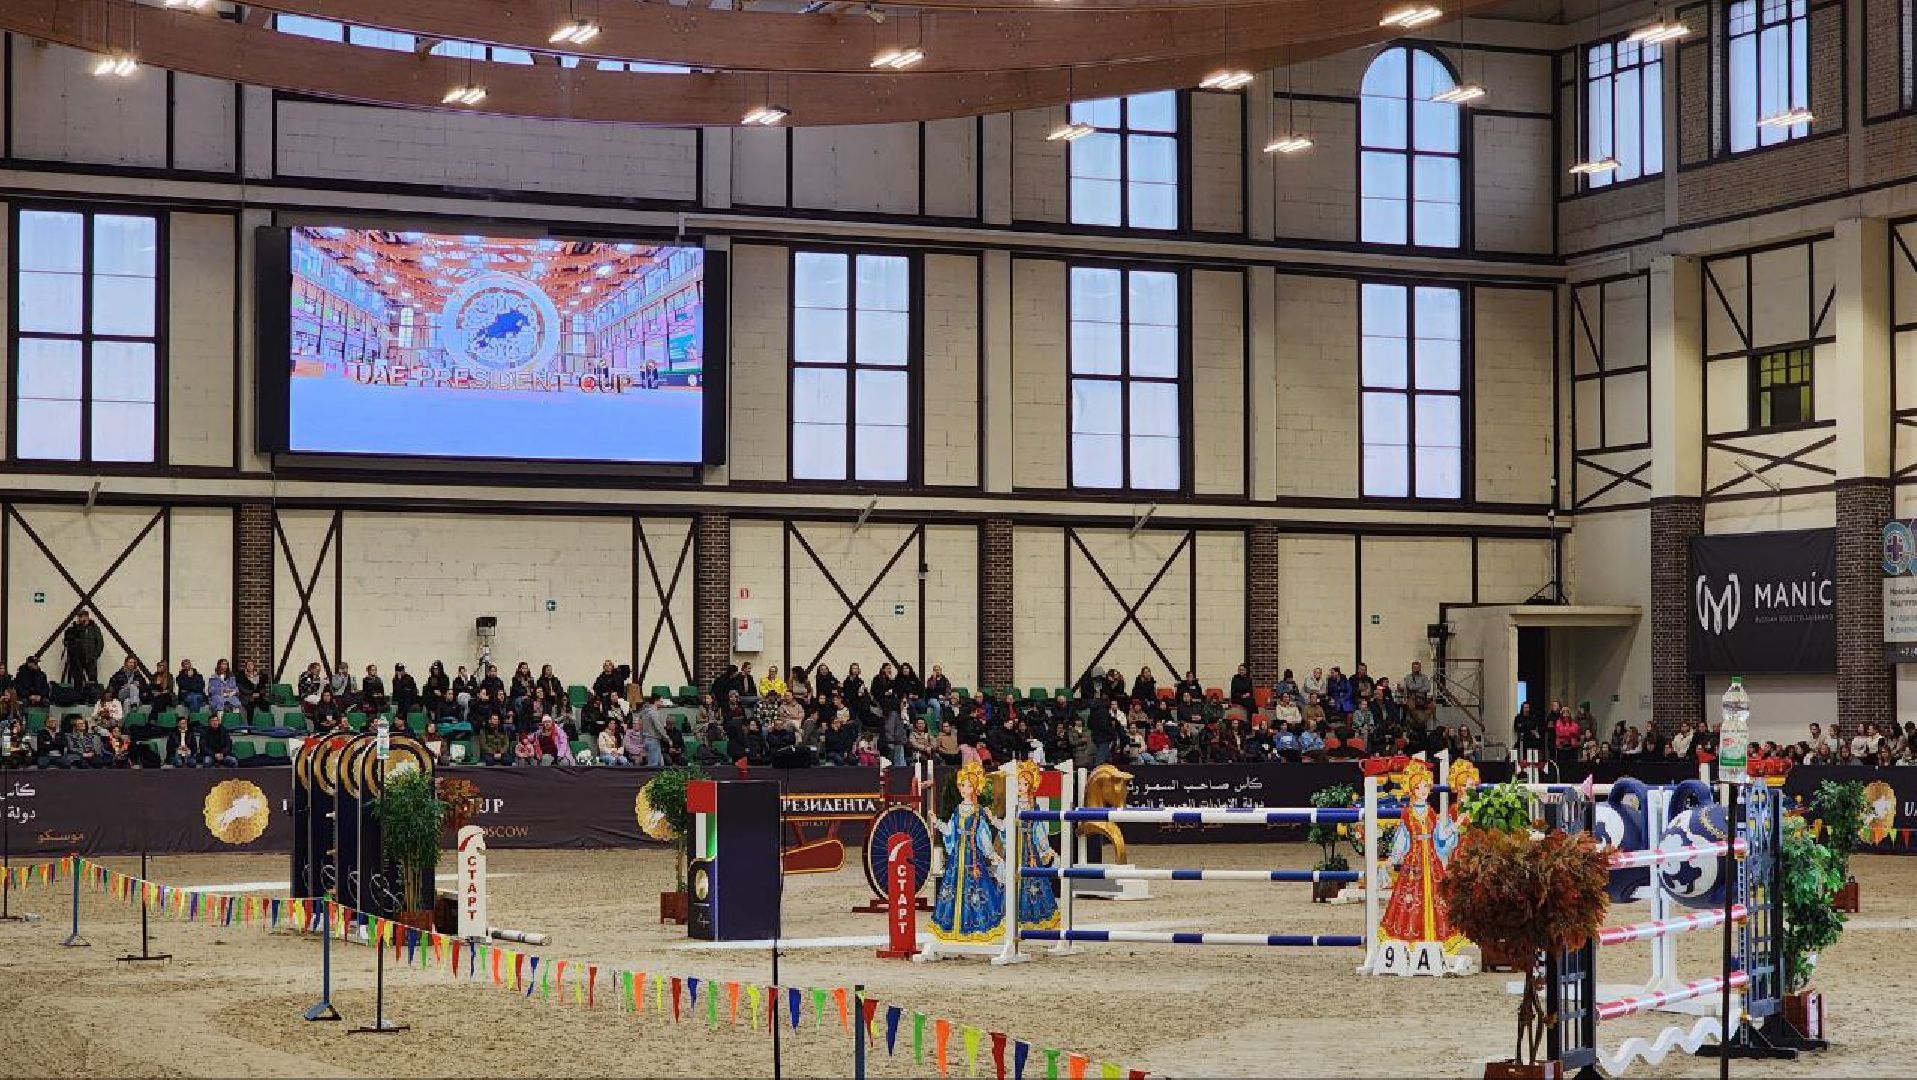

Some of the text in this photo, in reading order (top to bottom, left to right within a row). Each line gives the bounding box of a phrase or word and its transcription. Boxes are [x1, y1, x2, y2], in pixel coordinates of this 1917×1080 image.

[419, 366, 562, 393] PRESIDENT
[781, 798, 877, 812] РЕЗИДЕНТА
[467, 855, 477, 920] СТАРТ
[897, 864, 908, 934] СТАРТ
[1385, 946, 1395, 968] 9
